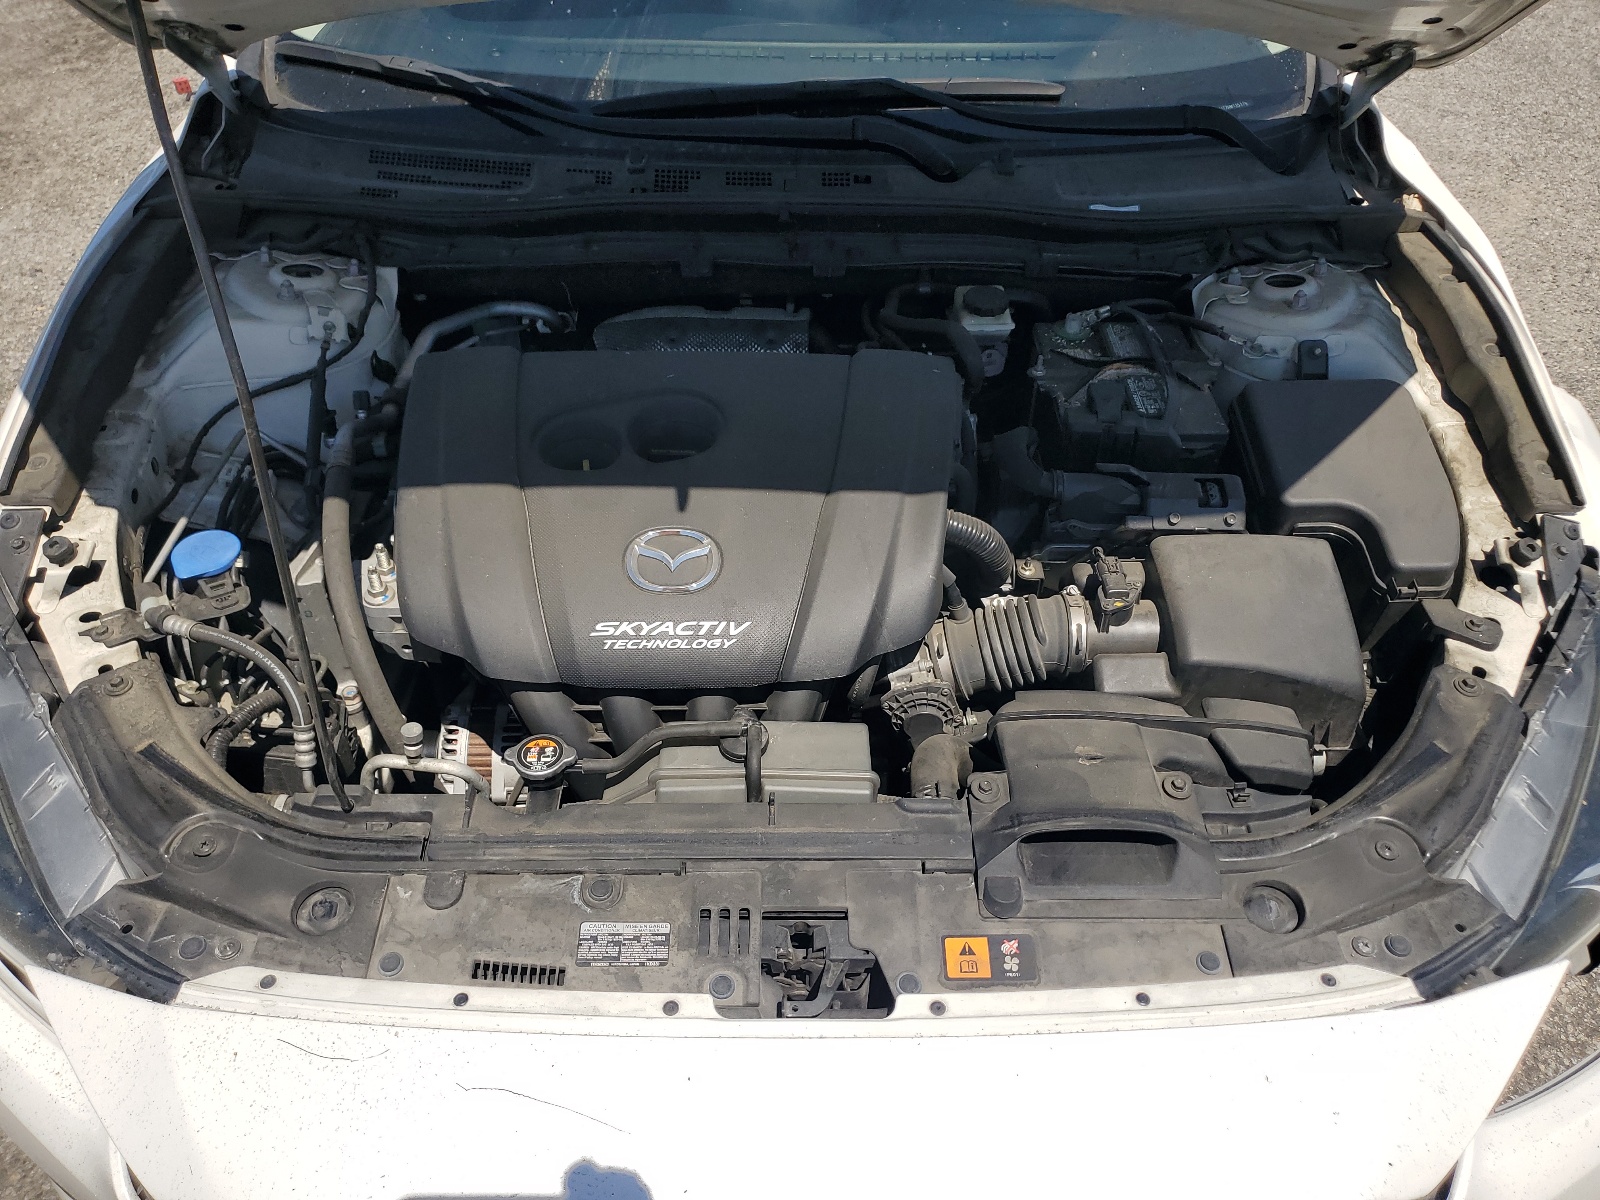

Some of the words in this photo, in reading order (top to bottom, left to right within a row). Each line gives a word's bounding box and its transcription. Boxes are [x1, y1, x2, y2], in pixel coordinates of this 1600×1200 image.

[589, 621, 752, 637] SKYACTIV
[603, 638, 738, 650] TECHNOLOGY
[262, 657, 285, 680] GALAXY
